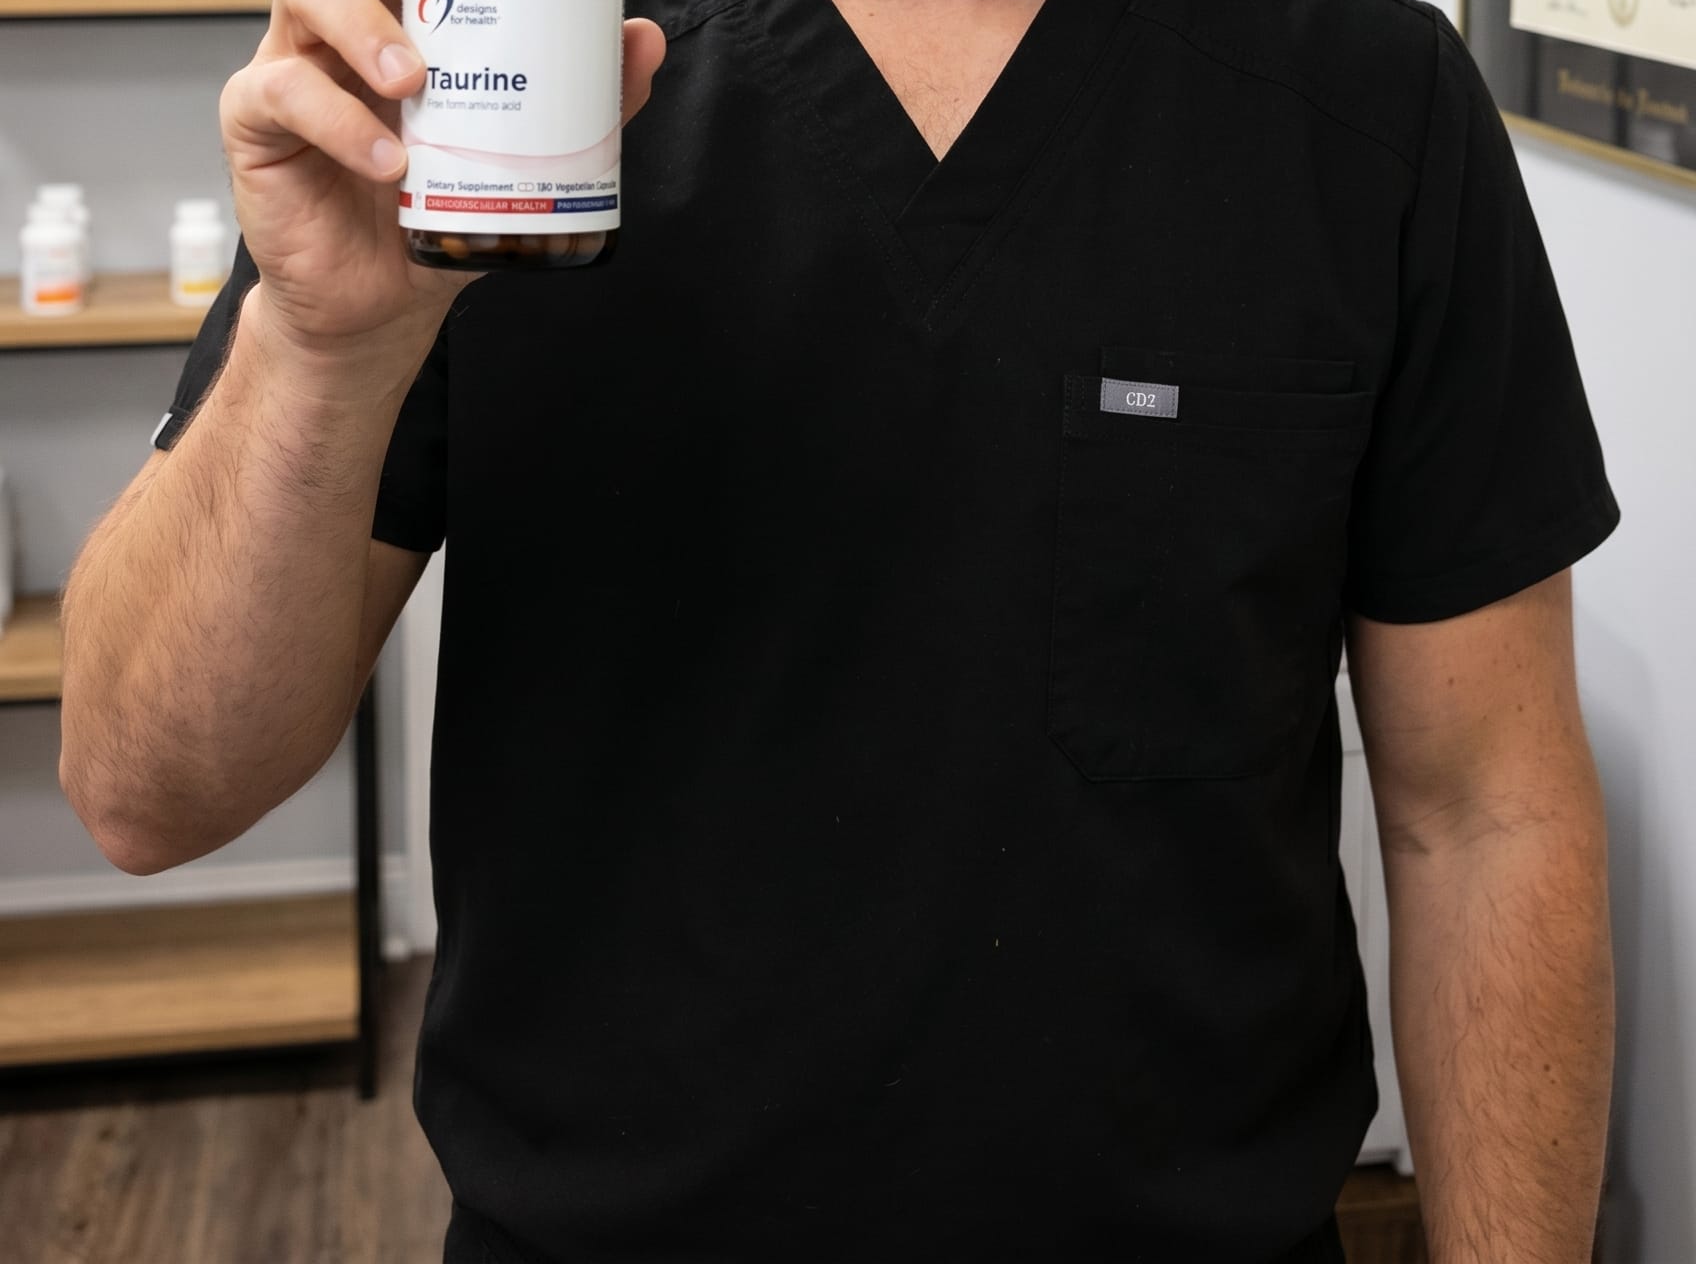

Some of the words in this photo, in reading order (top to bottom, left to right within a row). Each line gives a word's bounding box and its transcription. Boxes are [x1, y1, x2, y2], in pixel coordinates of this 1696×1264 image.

[456, 4, 498, 15] designs
[450, 15, 464, 25] for
[465, 15, 497, 25] health
[427, 67, 528, 92] Taurine
[426, 179, 455, 192] Dietary
[457, 181, 514, 192] Supplement
[511, 201, 546, 211] HEALTH
[1126, 391, 1156, 408] CD2
